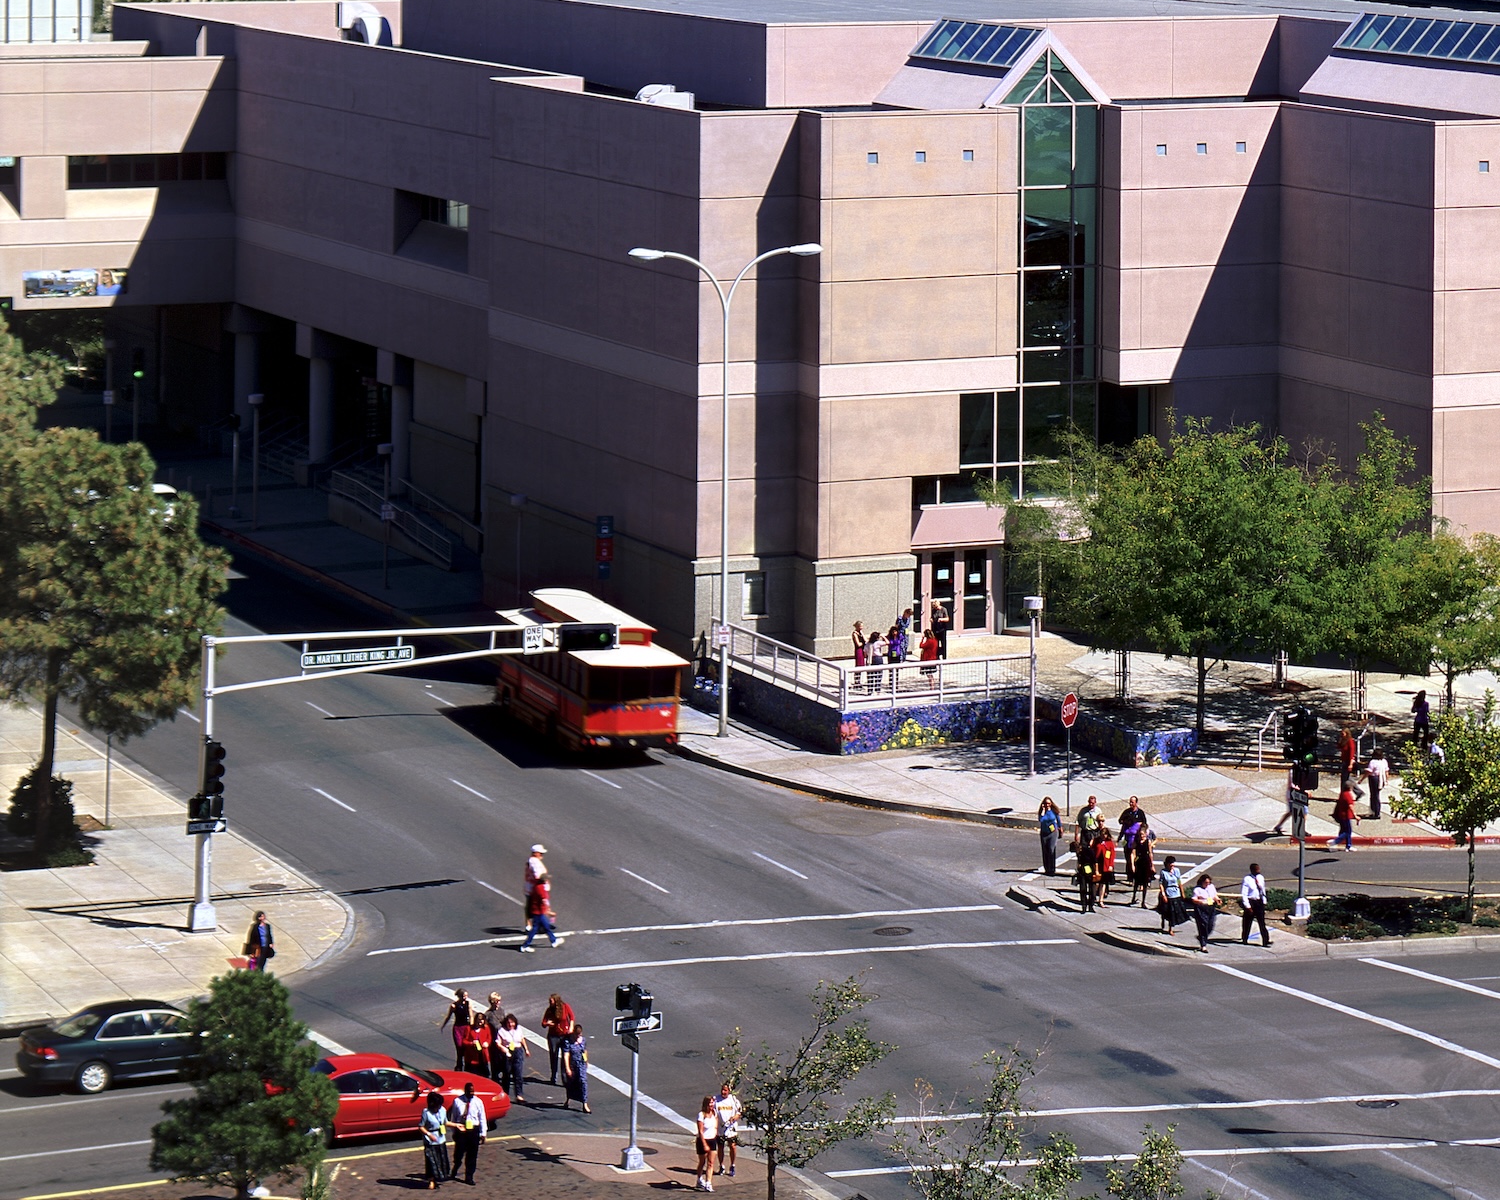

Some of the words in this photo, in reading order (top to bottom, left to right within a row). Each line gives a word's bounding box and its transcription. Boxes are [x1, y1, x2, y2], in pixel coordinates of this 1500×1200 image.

[526, 627, 541, 635] ONE
[304, 656, 315, 665] DR.
[316, 653, 341, 664] MARTIN
[343, 652, 368, 662] LUTHER
[369, 651, 385, 661] KING
[386, 649, 397, 659] JR.
[398, 648, 411, 658] AVE
[1064, 702, 1075, 717] STOP
[620, 1021, 633, 1029] ONE
[636, 1019, 651, 1027] WAY
